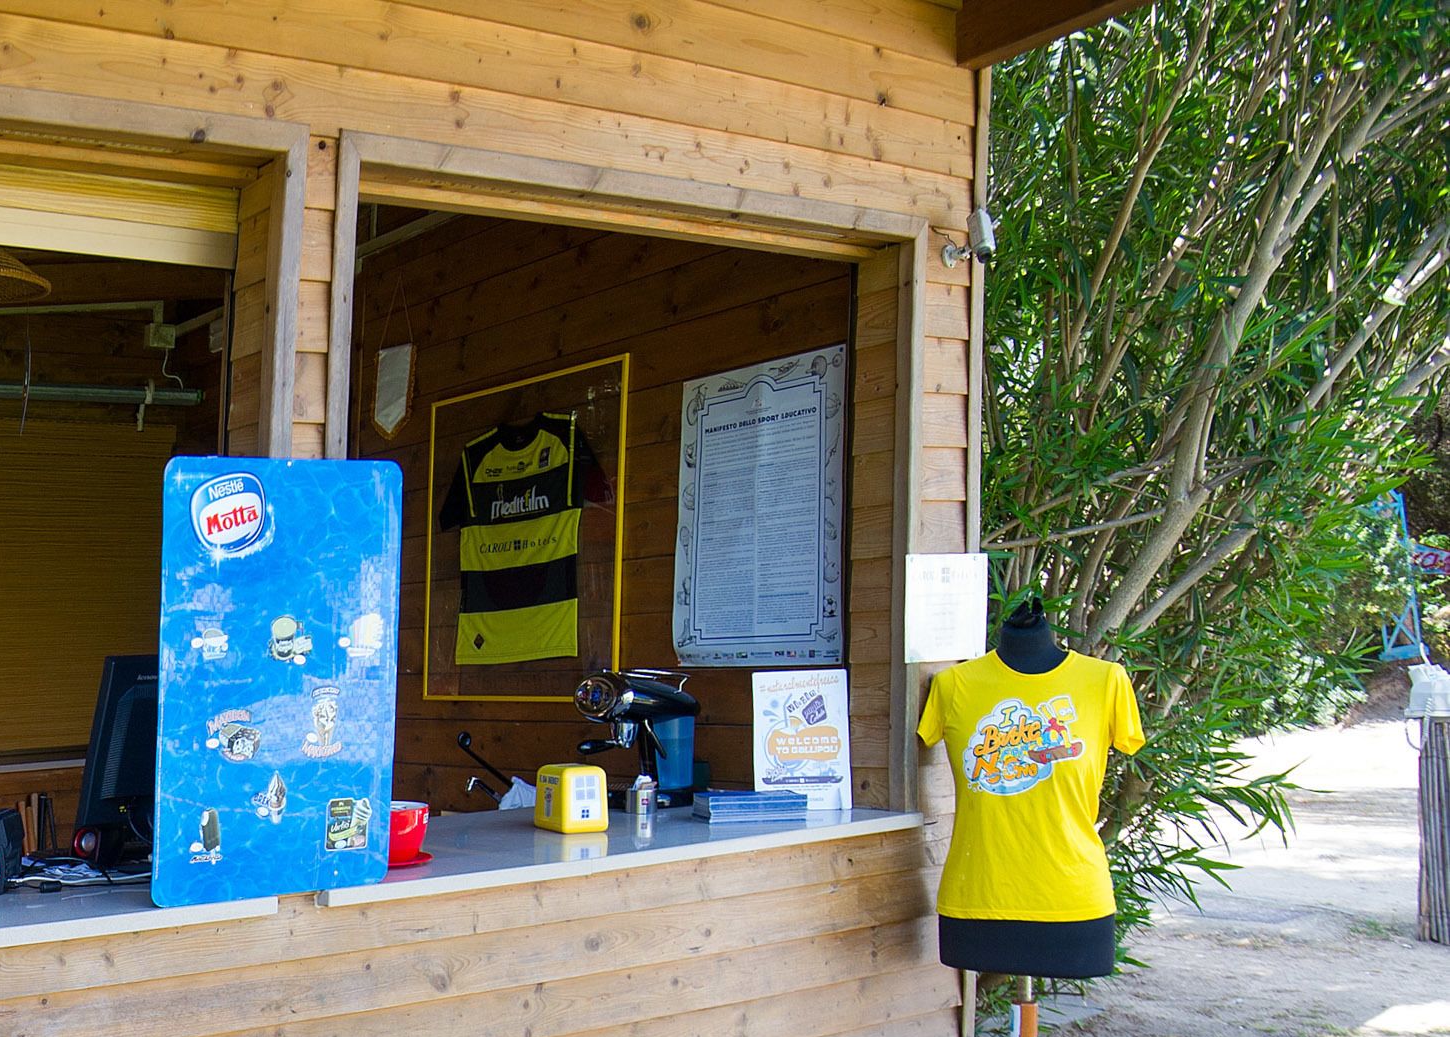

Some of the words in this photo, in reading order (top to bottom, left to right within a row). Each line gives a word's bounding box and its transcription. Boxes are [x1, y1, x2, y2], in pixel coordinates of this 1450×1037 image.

[705, 422, 738, 435] MANIFESTO
[738, 418, 757, 429] DELLO
[757, 413, 780, 425] SPORT
[781, 406, 818, 420] EDUCATIVO
[206, 505, 259, 536] Motta
[998, 705, 1018, 729] I
